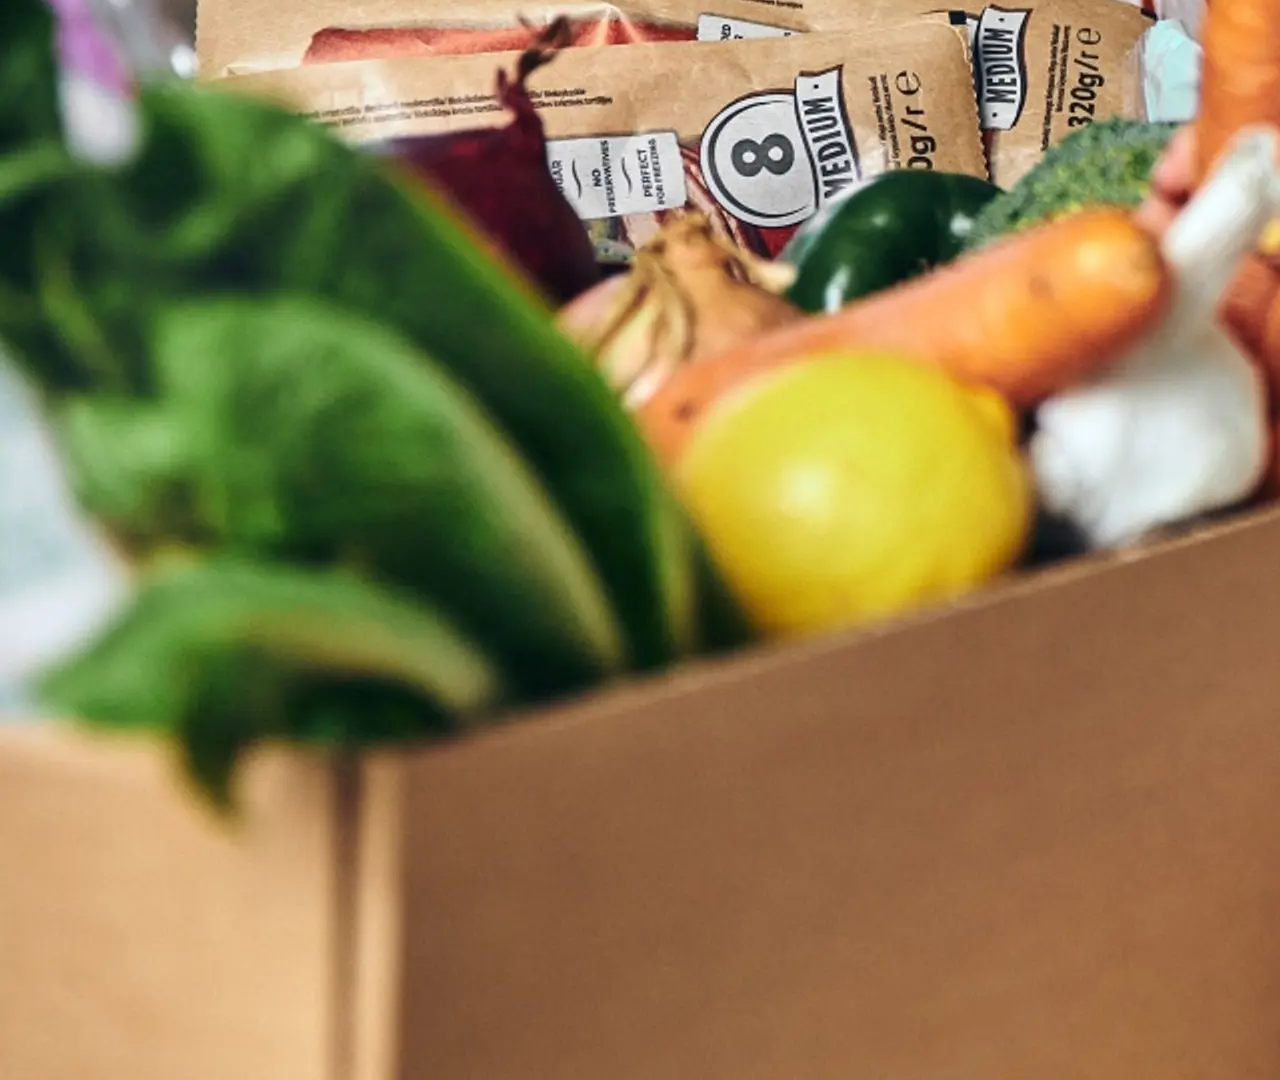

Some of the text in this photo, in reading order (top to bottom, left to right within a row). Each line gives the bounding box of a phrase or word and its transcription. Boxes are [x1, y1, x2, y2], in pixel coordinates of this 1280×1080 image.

[982, 28, 1018, 103] MEDIUM
[1068, 50, 1104, 128] 320g/r
[592, 167, 603, 188] NO
[600, 140, 617, 214] PRESERVATIVES
[636, 148, 653, 198] PERFECT
[648, 138, 665, 205] FOR FREEZING
[731, 133, 795, 177] 8
[802, 96, 853, 199] MEDIUM
